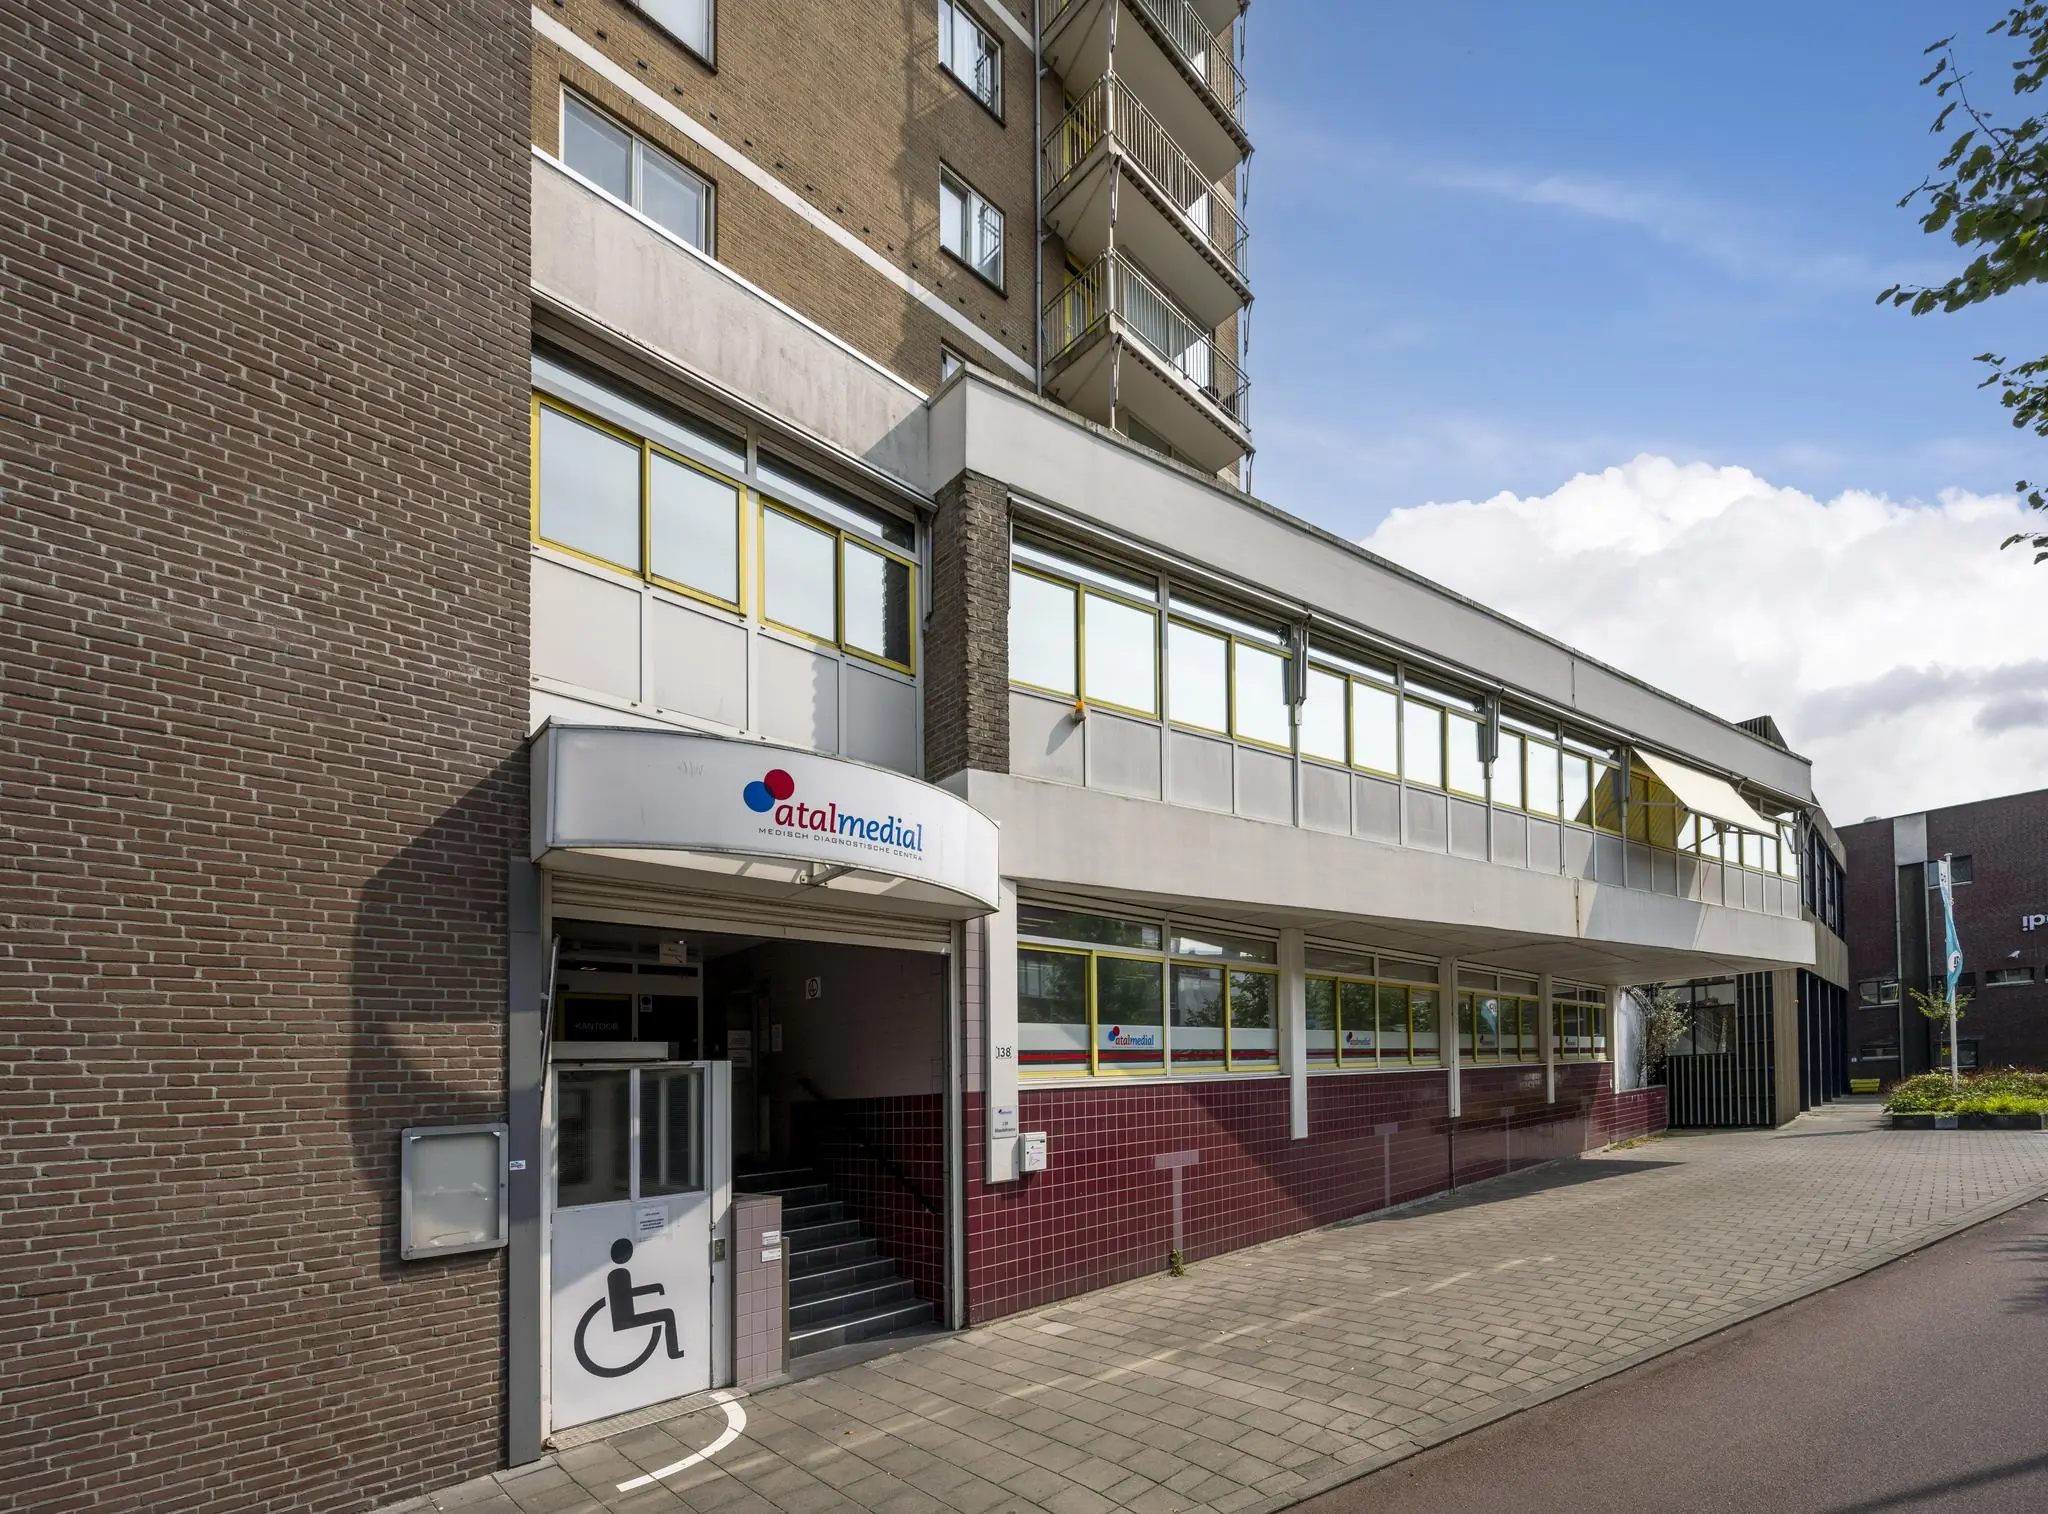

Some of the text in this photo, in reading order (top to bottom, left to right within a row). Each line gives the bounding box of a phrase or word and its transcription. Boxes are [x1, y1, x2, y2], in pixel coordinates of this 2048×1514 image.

[775, 802, 923, 852] atalmedial
[758, 827, 923, 861] MEDISCH DIAGNOSTISCHE CENTRA
[1115, 1034, 1155, 1046] atalmedial
[997, 1047, 1011, 1058] 138
